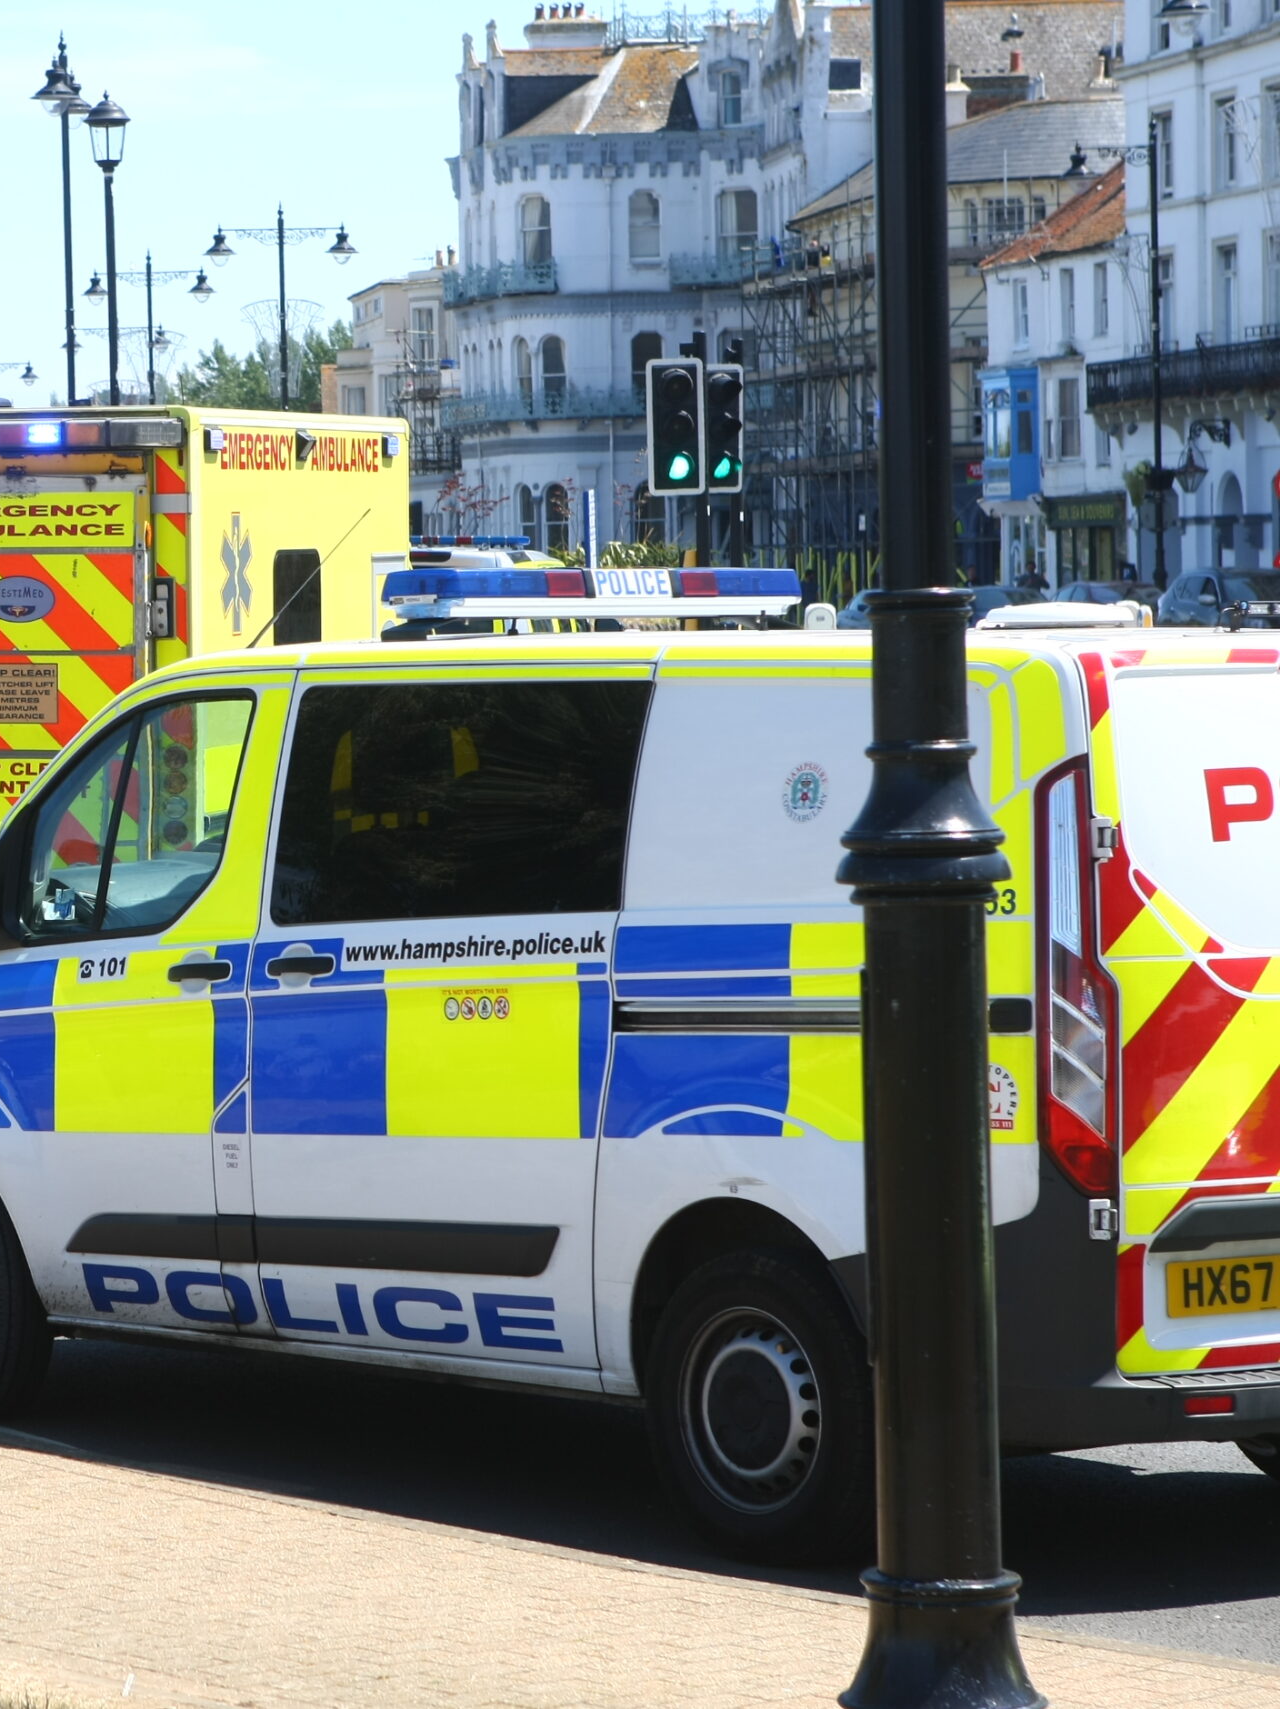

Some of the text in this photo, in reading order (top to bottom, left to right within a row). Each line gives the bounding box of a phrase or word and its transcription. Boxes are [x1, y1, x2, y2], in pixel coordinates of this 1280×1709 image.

[220, 433, 379, 472] EMERGENCY AMBULANCE
[595, 570, 669, 596] POLICE
[11, 669, 55, 678] CLEAR!
[784, 762, 828, 785] HAMPSHIRE
[1204, 767, 1280, 842] P
[345, 930, 606, 963] www.hampshire.police.uk
[98, 957, 127, 977] 101
[222, 1143, 241, 1151] DIESEL
[225, 1152, 238, 1160] FUEL
[226, 1161, 239, 1169] ONLY
[1183, 1262, 1273, 1308] HX67
[82, 1263, 564, 1353] POLICE
